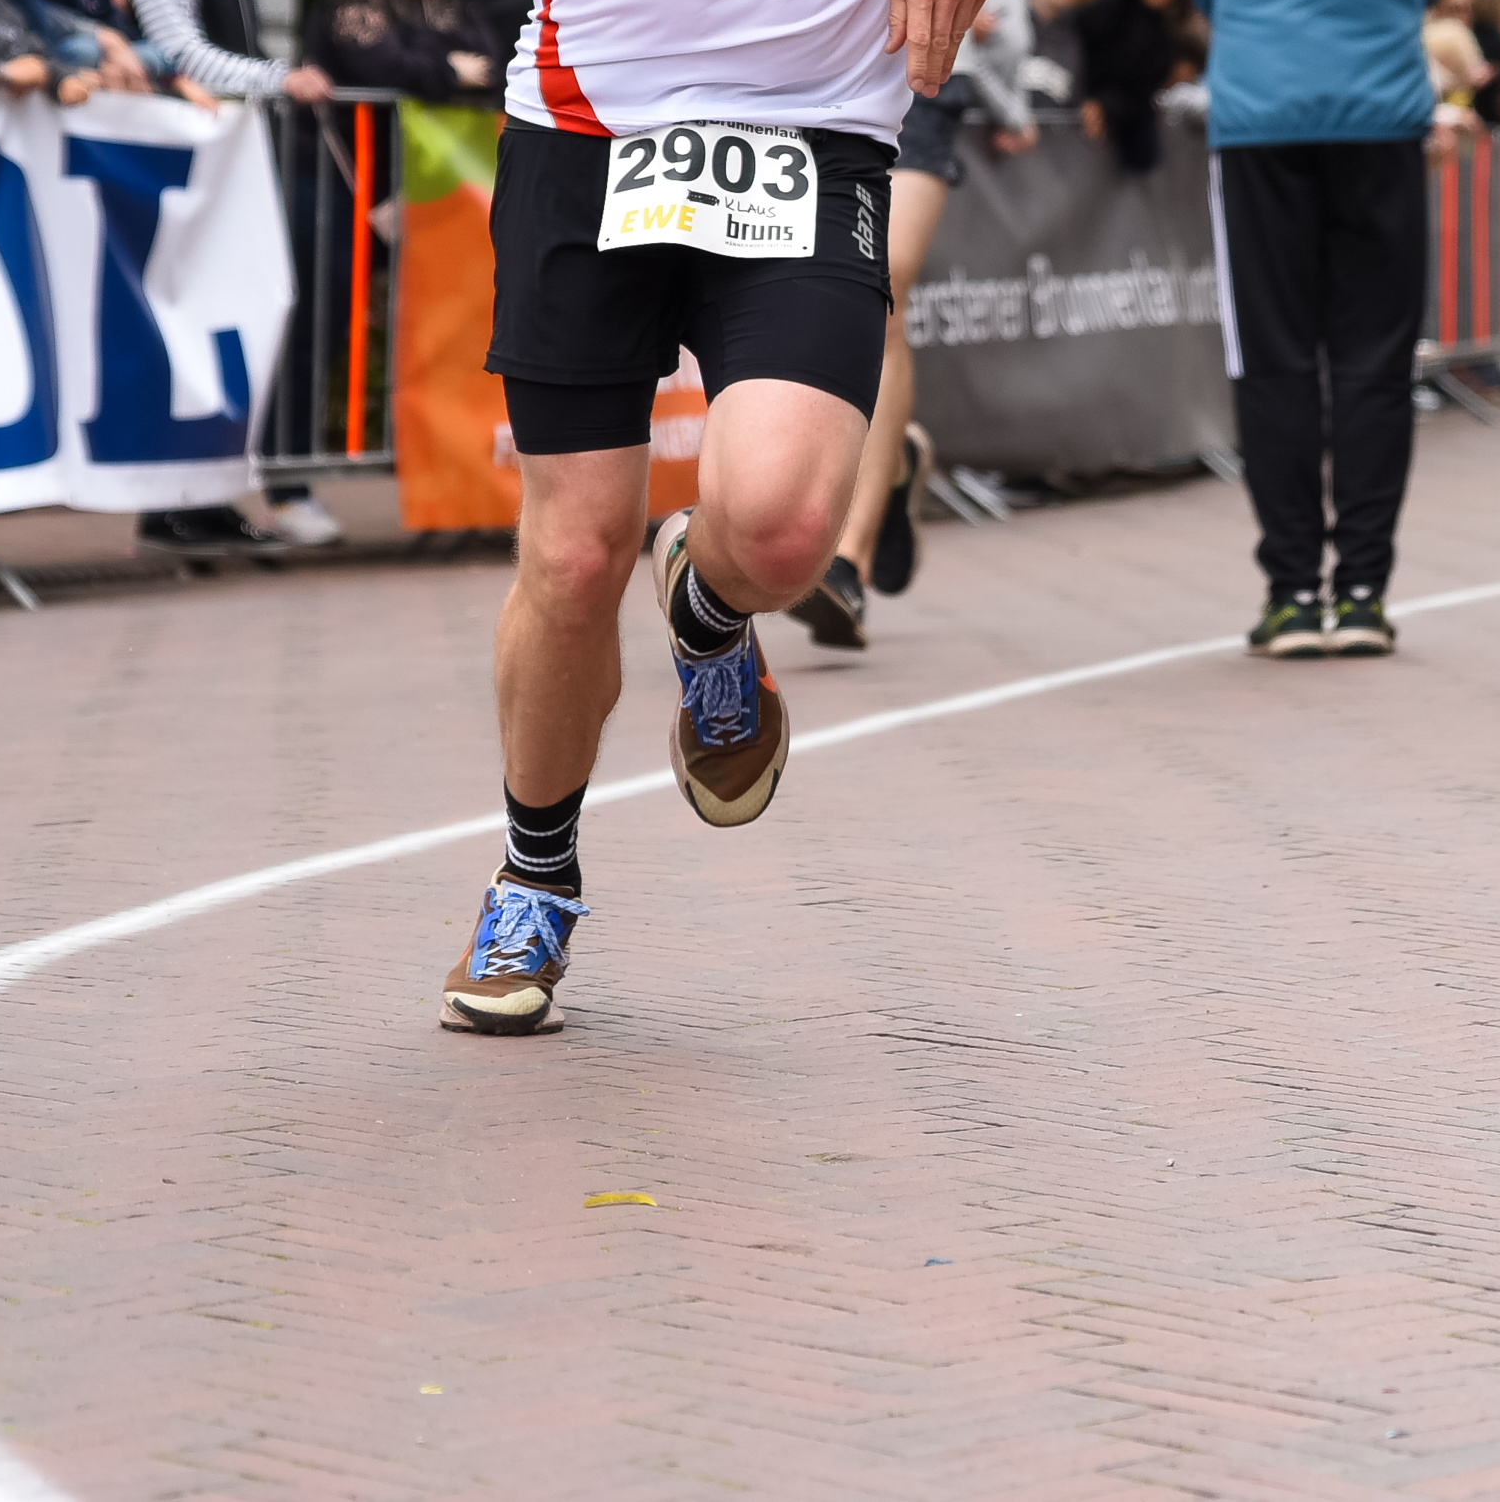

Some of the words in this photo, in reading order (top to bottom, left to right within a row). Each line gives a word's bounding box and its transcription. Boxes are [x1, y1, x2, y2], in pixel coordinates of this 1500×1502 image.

[613, 127, 810, 201] 2903
[619, 204, 697, 234] EWE
[725, 196, 777, 218] KLAUS
[726, 213, 794, 241] bruns
